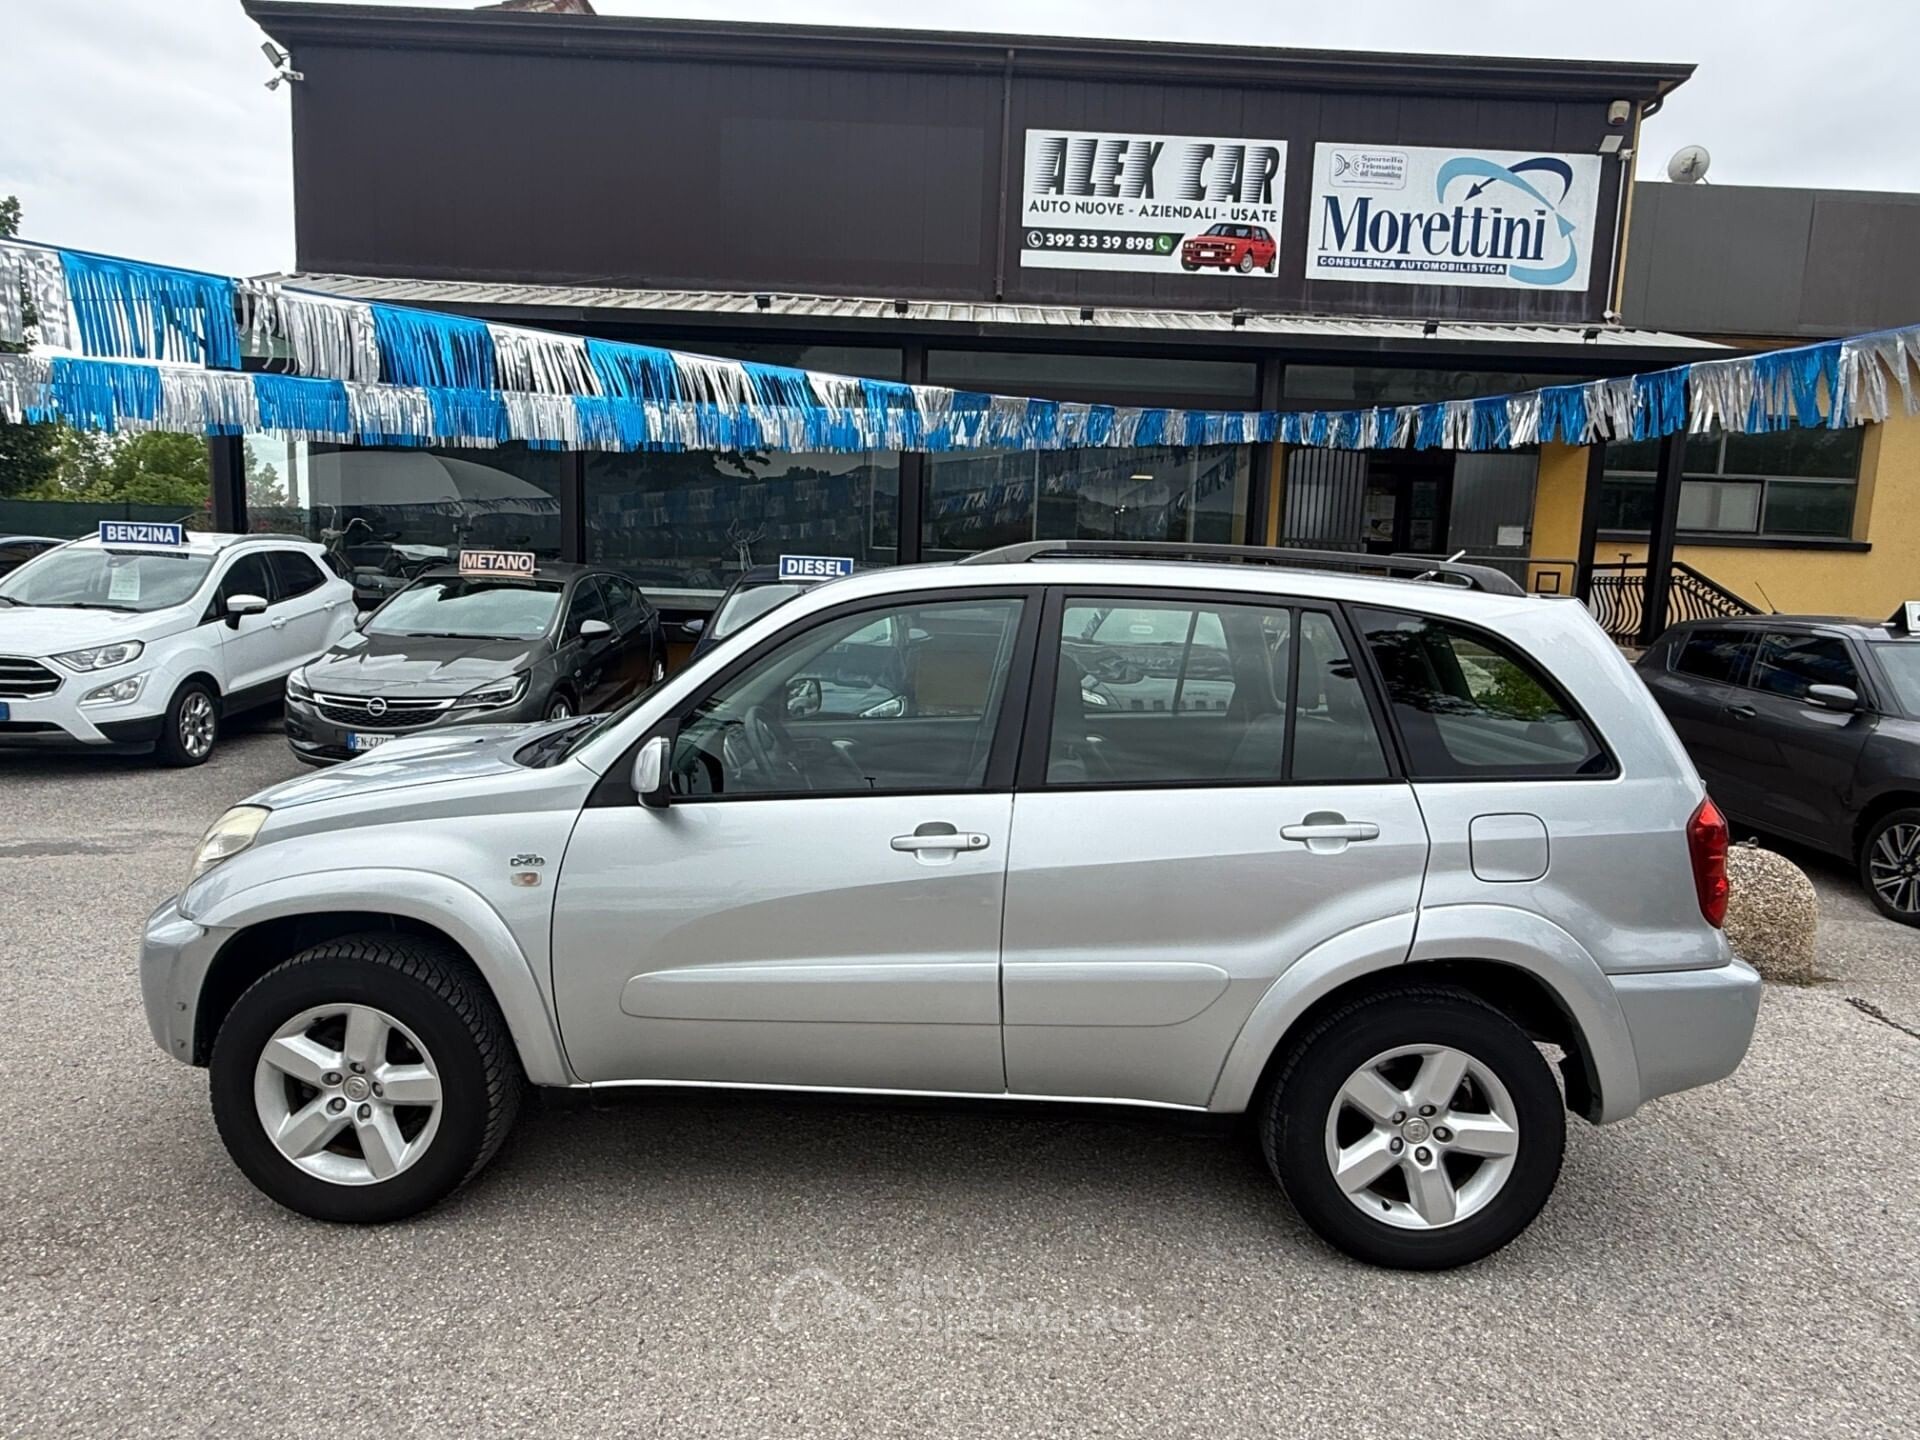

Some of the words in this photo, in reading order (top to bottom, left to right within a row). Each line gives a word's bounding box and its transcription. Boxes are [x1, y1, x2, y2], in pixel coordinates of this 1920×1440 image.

[1031, 137, 1165, 199] ALEX
[1176, 143, 1281, 204] CAR
[1029, 200, 1071, 213] AUTO
[1075, 202, 1124, 215] NUOVE
[1138, 205, 1217, 219] AZIENDALI
[1230, 208, 1277, 222] USATE
[1318, 195, 1547, 261] Morettini
[1045, 233, 1075, 247] 392
[1079, 235, 1098, 248] 33
[1102, 236, 1121, 249] 39
[1125, 237, 1154, 250] 898
[1319, 257, 1396, 269] CONSULENZA
[1400, 261, 1505, 274] AUTOMOBILISTICA
[106, 525, 175, 543] BENZINA
[463, 553, 531, 571] METANO
[786, 559, 846, 576] DIESEL
